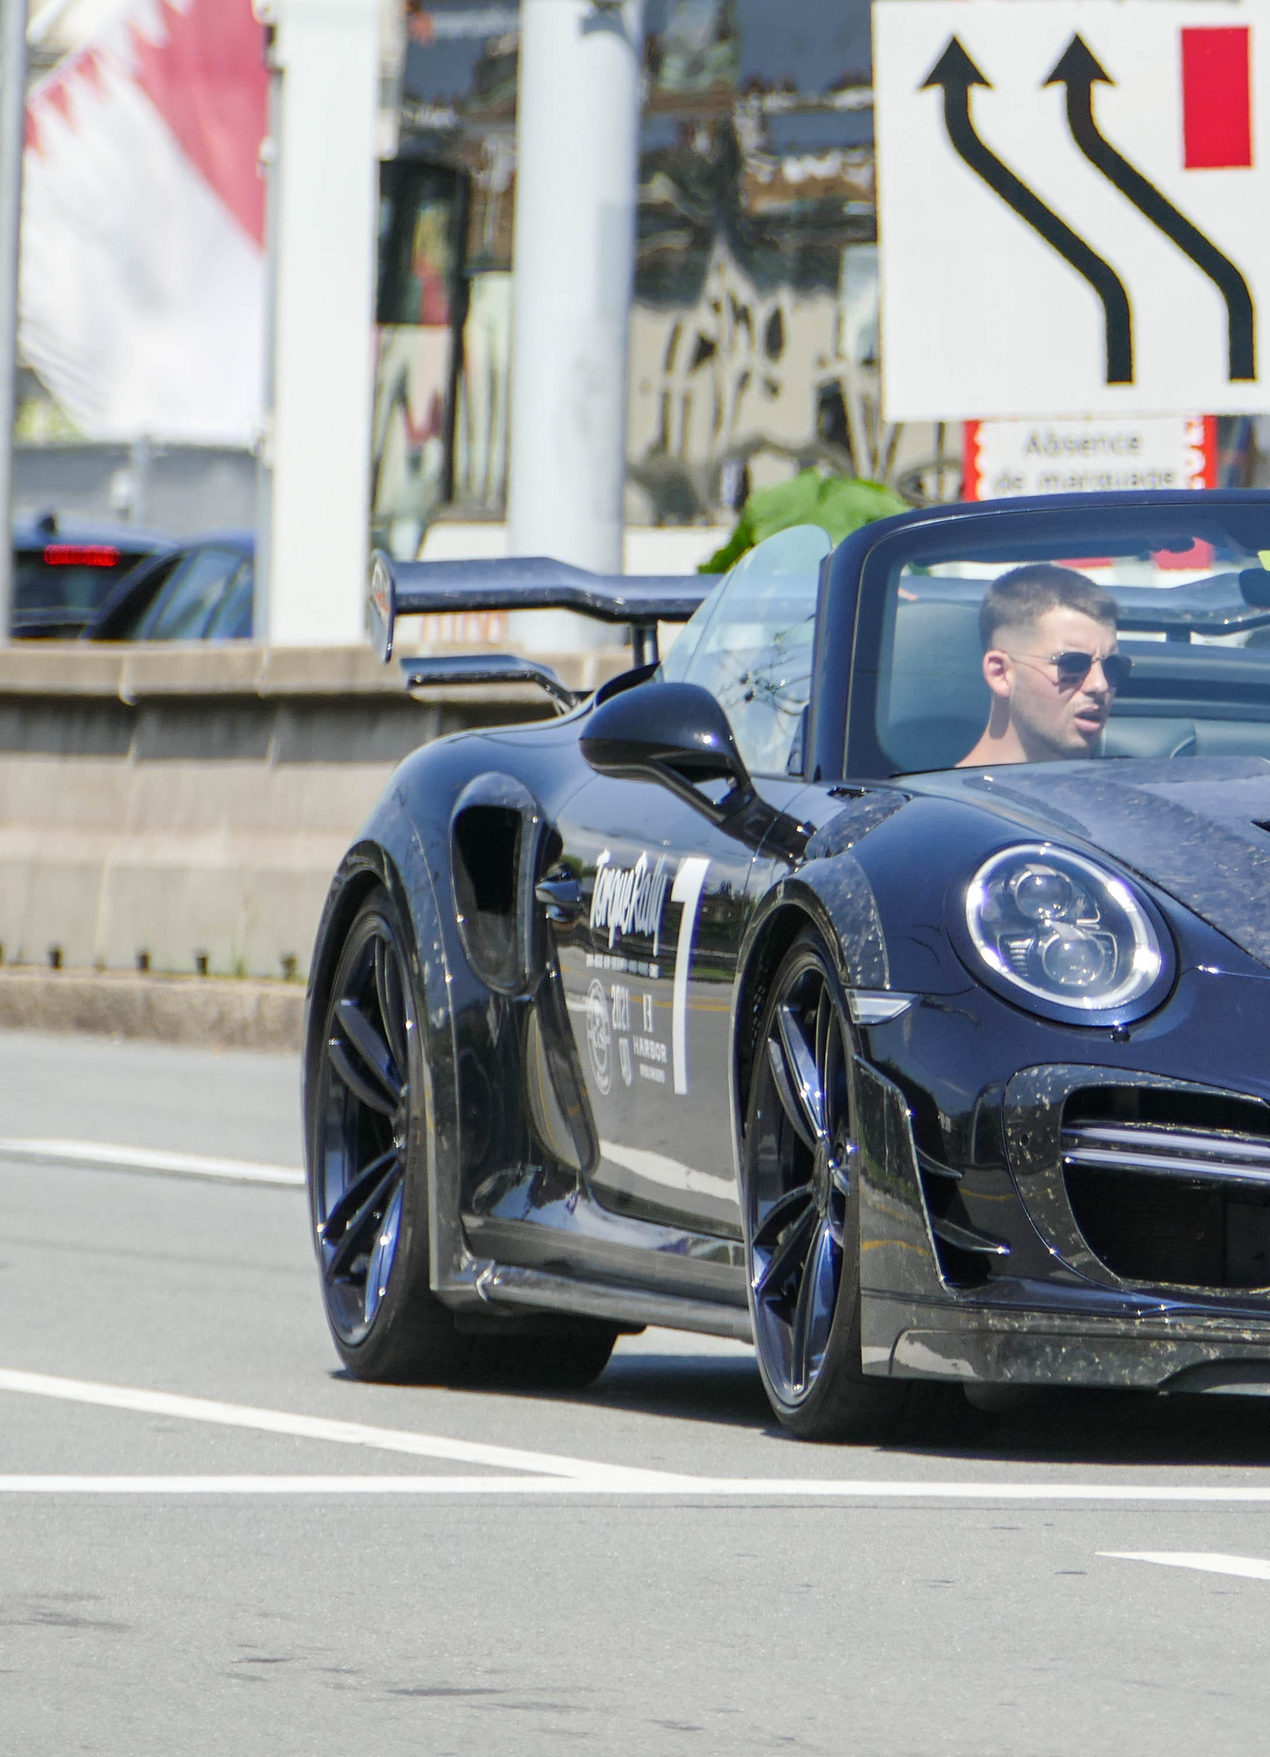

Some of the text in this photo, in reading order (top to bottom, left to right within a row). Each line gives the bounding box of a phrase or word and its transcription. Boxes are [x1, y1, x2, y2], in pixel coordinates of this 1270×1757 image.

[1025, 429, 1142, 456] Absence
[995, 468, 1025, 493] de
[671, 857, 711, 1095] 1
[632, 1035, 668, 1064] HARBOR
